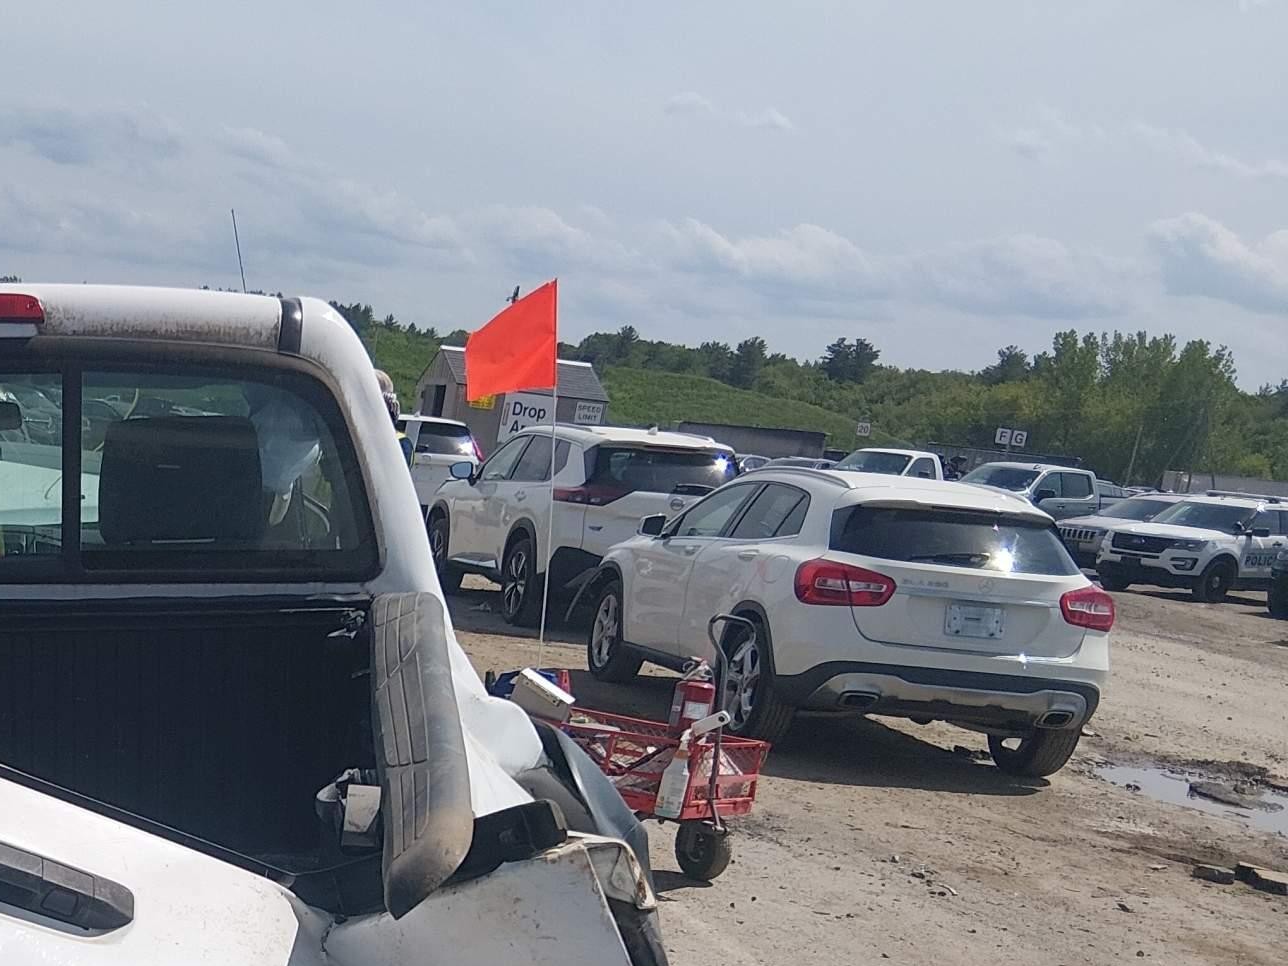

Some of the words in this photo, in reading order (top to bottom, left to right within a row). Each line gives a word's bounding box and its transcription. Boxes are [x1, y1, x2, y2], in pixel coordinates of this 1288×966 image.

[512, 401, 546, 422] Drop
[578, 403, 601, 412] SPEED
[577, 413, 598, 421] LIMIT
[858, 425, 869, 434] 20
[999, 432, 1008, 442] F
[1014, 433, 1024, 444] G
[1245, 555, 1274, 567] POLIC
